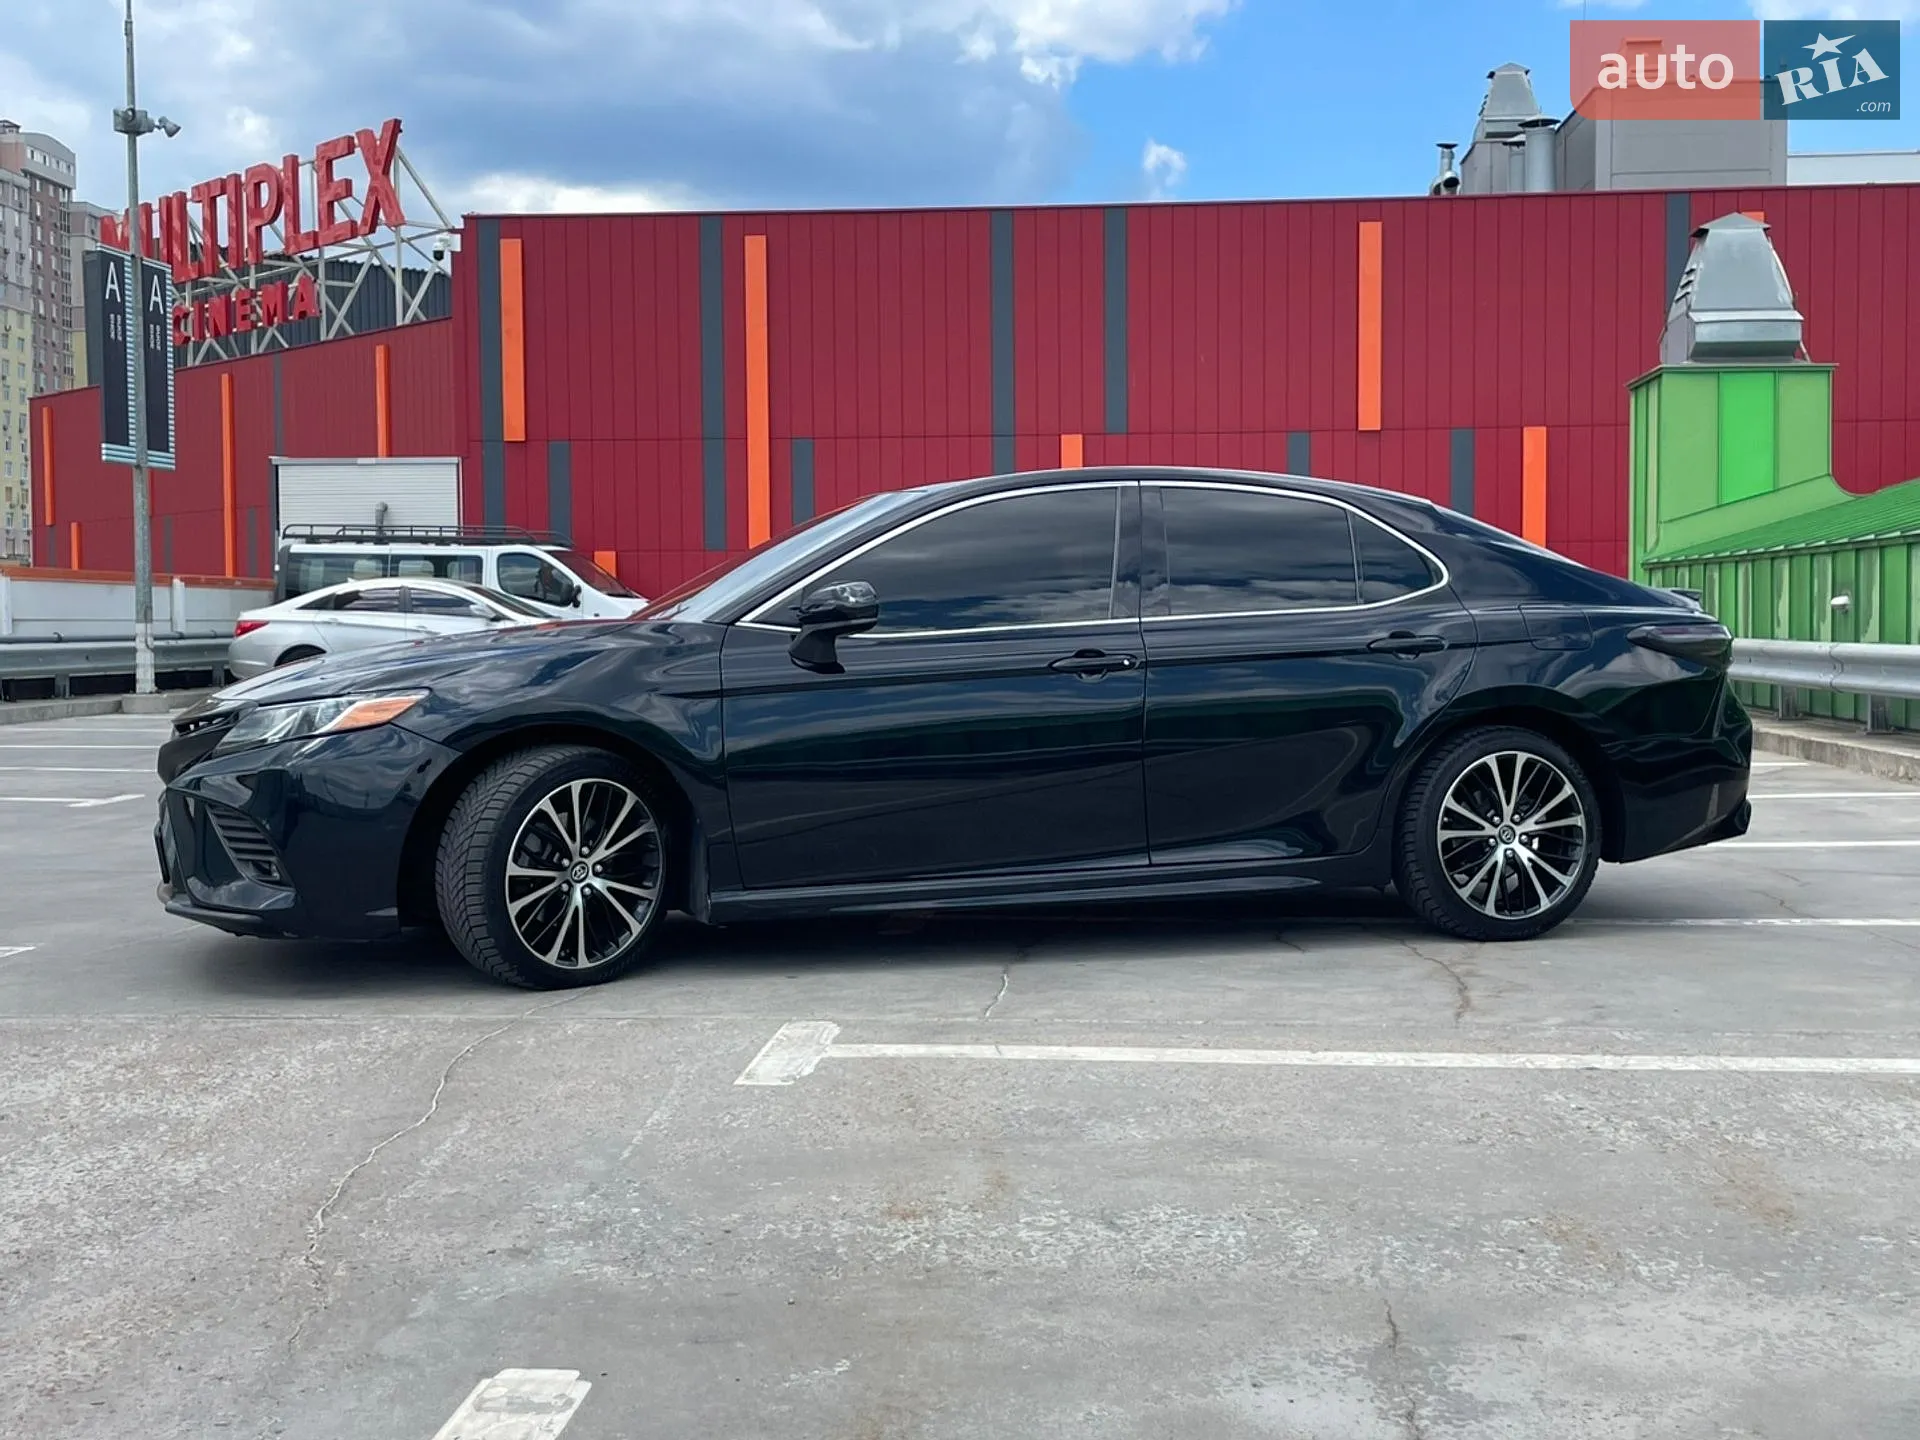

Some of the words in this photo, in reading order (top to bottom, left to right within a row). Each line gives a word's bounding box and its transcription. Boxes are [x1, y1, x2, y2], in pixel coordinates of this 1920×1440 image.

[105, 261, 121, 303] A
[149, 274, 164, 315] A
[172, 274, 321, 347] CINEMA
